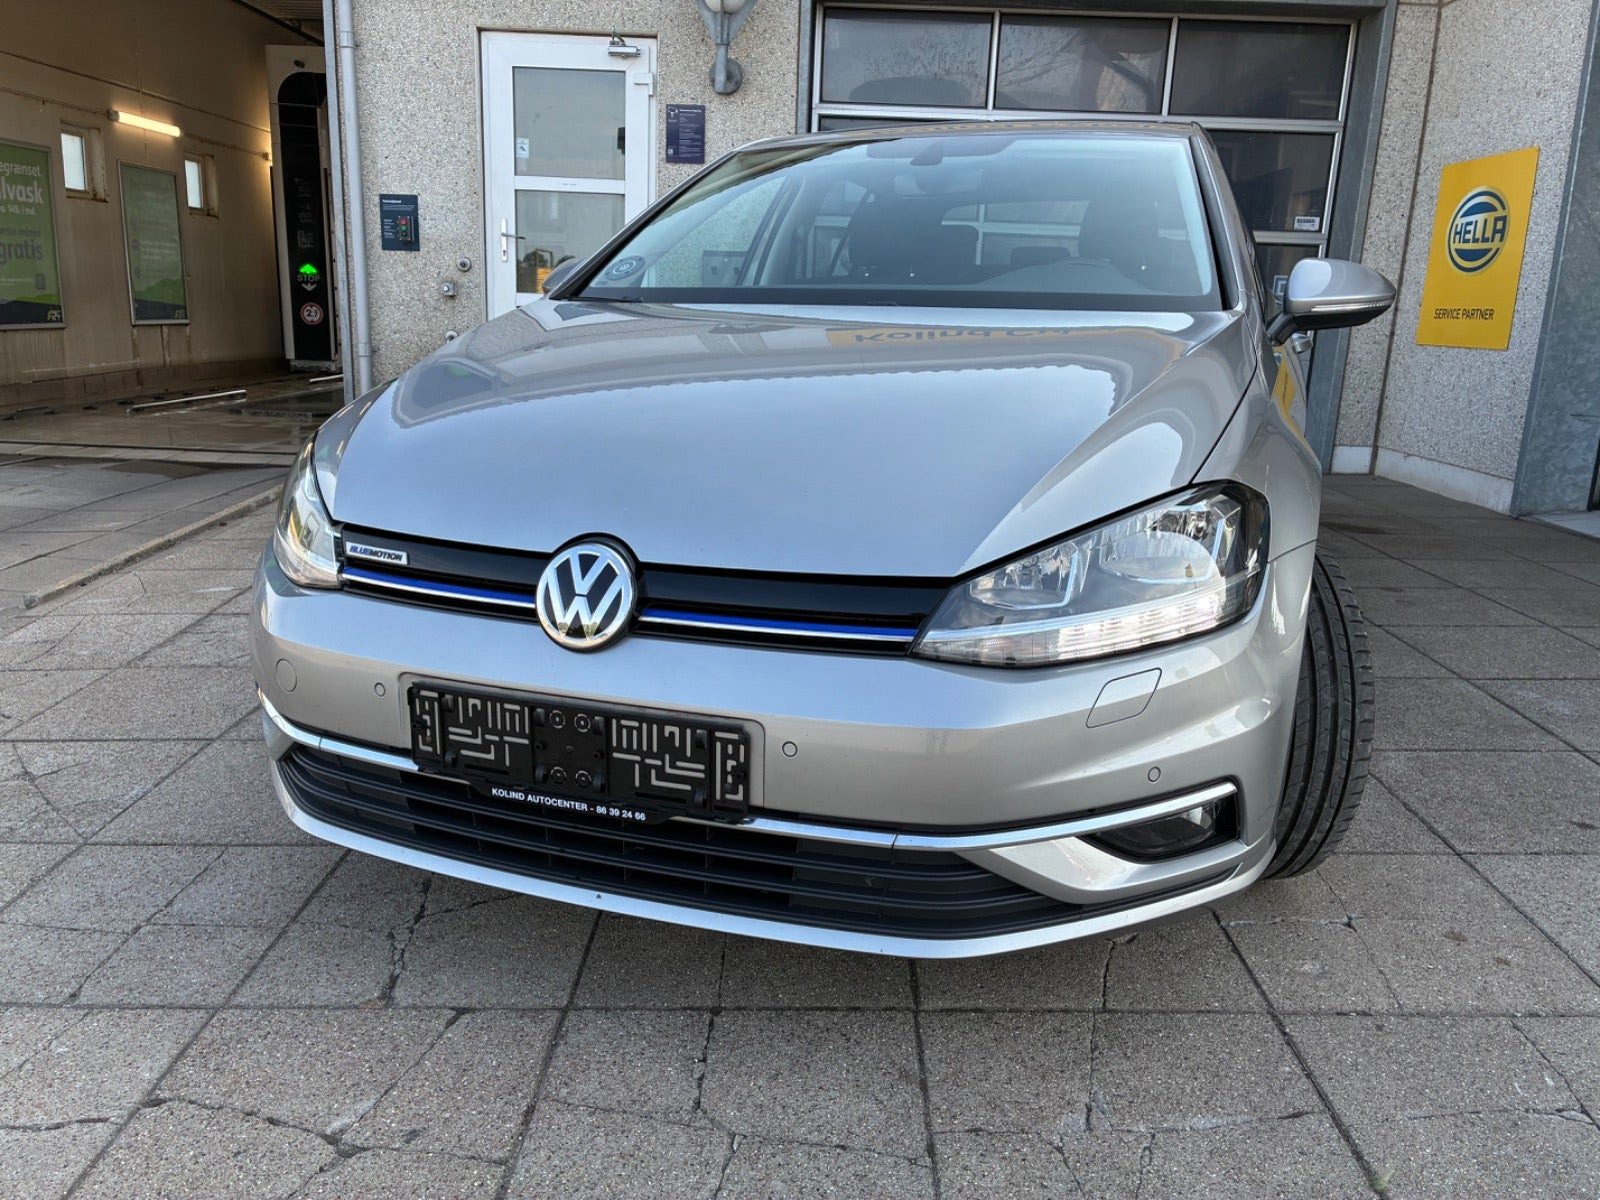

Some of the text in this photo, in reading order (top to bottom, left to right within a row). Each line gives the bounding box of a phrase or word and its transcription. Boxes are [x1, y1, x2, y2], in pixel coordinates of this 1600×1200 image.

[0, 175, 43, 203] lvask
[1453, 215, 1507, 244] HELLA
[0, 239, 43, 265] gratis
[297, 273, 321, 282] STOP
[1434, 308, 1495, 320] SERVICE PARTNER
[350, 545, 403, 562] BLUEMOTION
[491, 787, 525, 801] KOLIND
[527, 794, 588, 812] AUTOCENTER
[596, 805, 607, 815] 86
[609, 807, 620, 816] 39
[621, 809, 633, 819] 24
